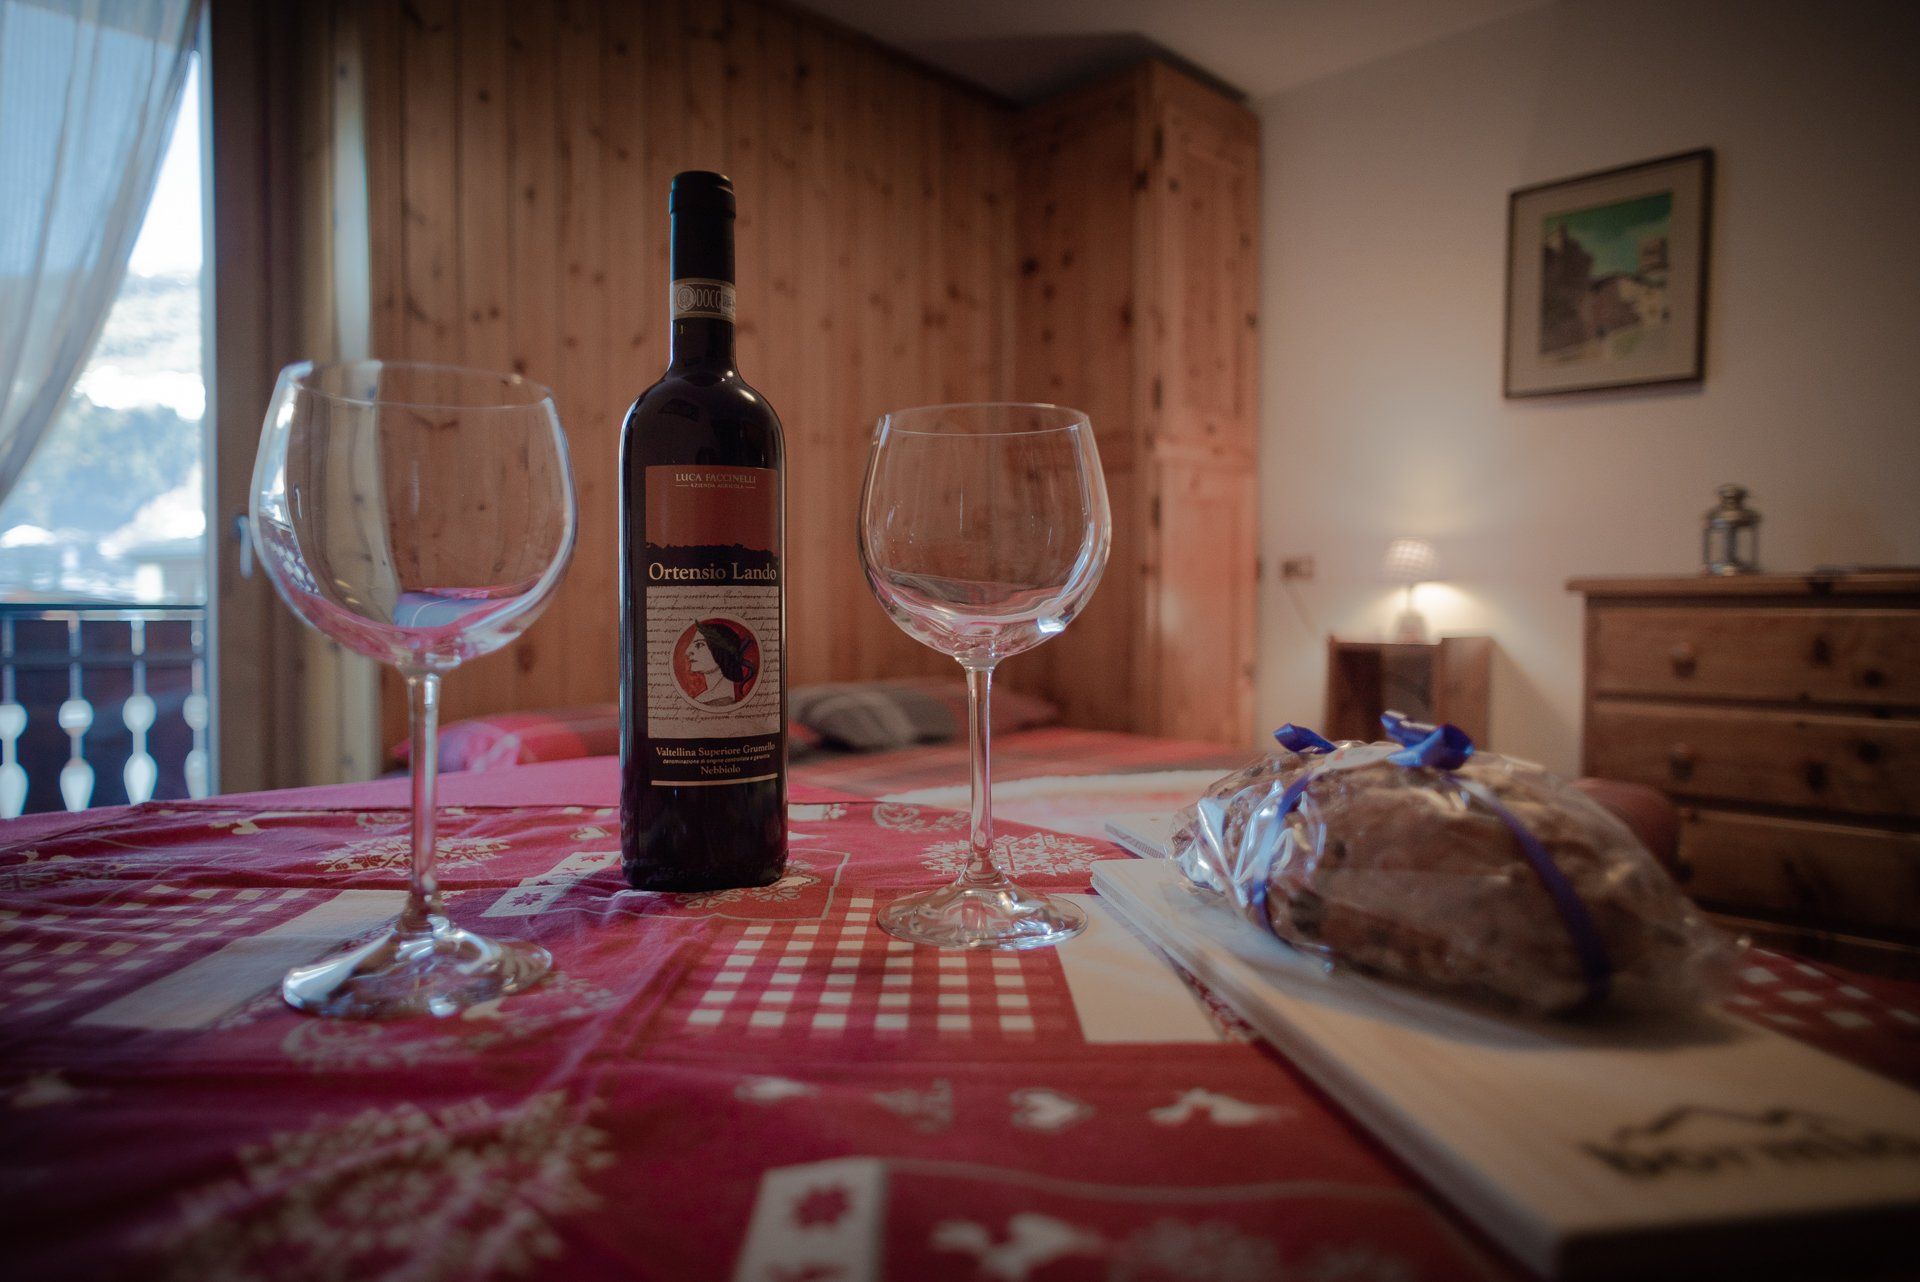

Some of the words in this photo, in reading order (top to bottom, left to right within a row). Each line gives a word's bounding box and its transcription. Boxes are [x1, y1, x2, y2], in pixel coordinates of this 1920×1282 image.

[675, 473, 702, 482] LUCA
[705, 474, 756, 484] FACCINELLI
[649, 562, 727, 580] Ortensio
[731, 561, 777, 580] Lando
[655, 746, 696, 757] Valtellina
[698, 747, 741, 758] Superiore
[742, 741, 776, 754] Grumello
[700, 764, 741, 775] Nebbiolo
